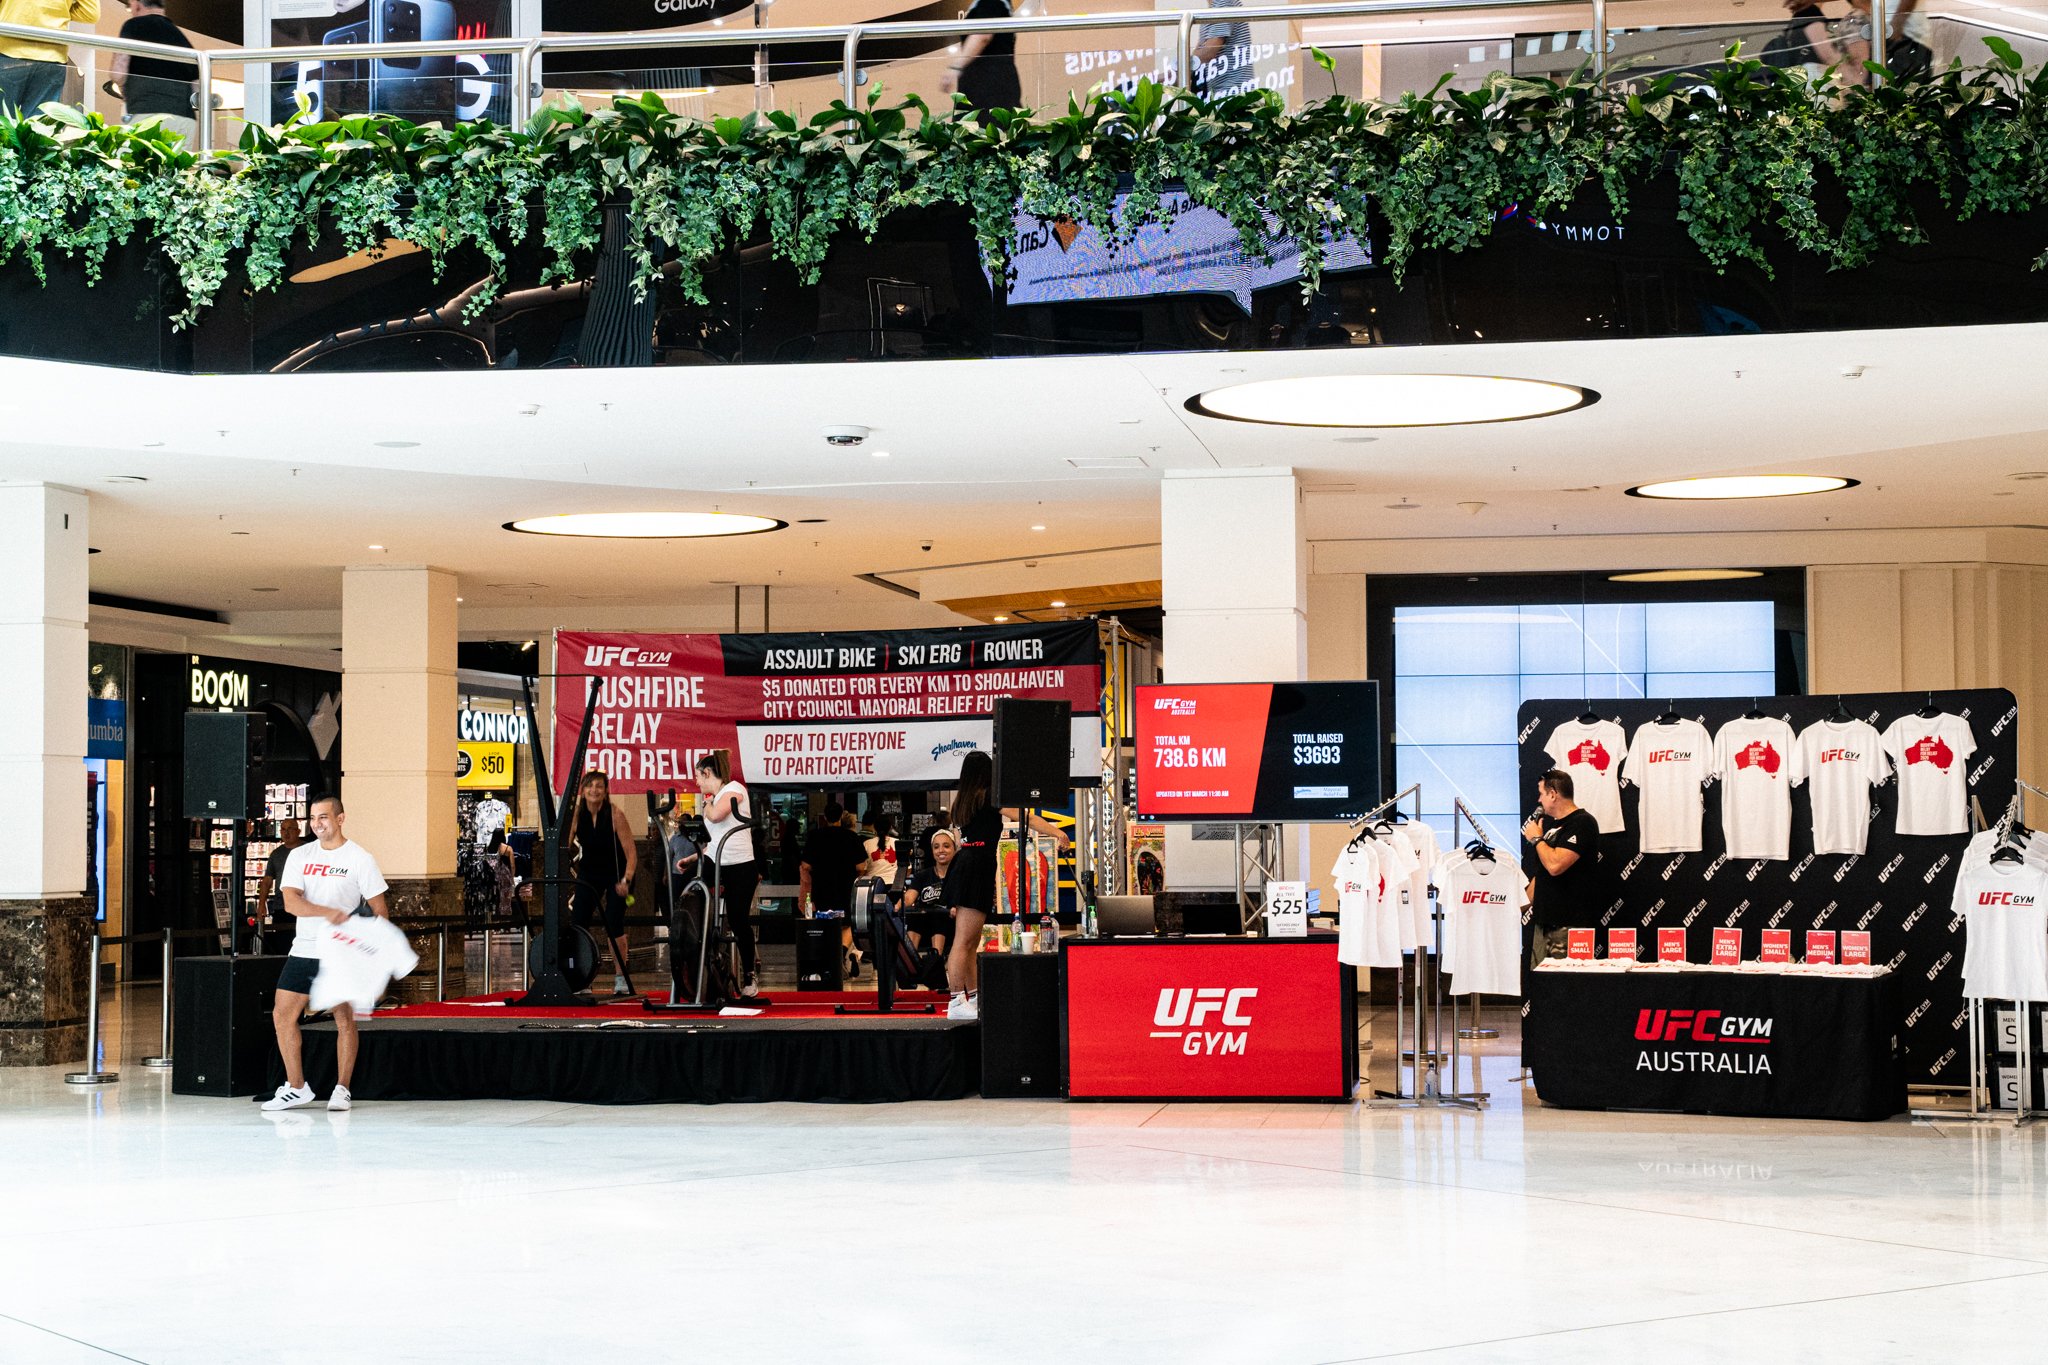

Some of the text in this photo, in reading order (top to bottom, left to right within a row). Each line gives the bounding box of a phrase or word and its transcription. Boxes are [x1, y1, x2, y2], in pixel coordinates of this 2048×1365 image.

[584, 646, 672, 667] UFC GYM
[763, 638, 1044, 670] ASSAULT BIKE SKI ERG ROWER
[762, 669, 1064, 698] $5 DONATED FOR EVERY KM TO SHOALHAVEN
[763, 693, 1012, 719] CITY COUNCIL MAYORAL RELIEF FU
[1154, 699, 1196, 709] UFC GYM
[460, 709, 528, 744] CONNOR
[1518, 724, 1532, 744] UFC
[1991, 715, 2010, 737] UFC
[764, 731, 906, 752] OPEN TO EVERYONE
[1155, 736, 1190, 746] TOTAL KM
[1293, 733, 1344, 744] TOTAL RAISED
[931, 739, 977, 761] Shoalhaven
[1153, 748, 1226, 768] 738.6 KM
[1293, 745, 1340, 766] $3693
[1649, 749, 1674, 763] UFC
[1820, 749, 1845, 763] UFC
[481, 756, 504, 774] $50
[763, 756, 874, 776] TO PARTICPATE
[1968, 765, 1987, 786] UFC
[303, 863, 348, 876] UFC GYM
[1620, 860, 1636, 881] UFC
[1661, 860, 1678, 881] UFC
[1703, 860, 1721, 882] UFC
[1746, 860, 1763, 882] UFC
[1789, 861, 1806, 883] UFC
[1833, 861, 1851, 883] UFC
[1878, 862, 1896, 884] UFC
[1923, 862, 1941, 884] UFC
[1272, 898, 1302, 917] $25
[1462, 891, 1490, 904] UFC
[1978, 892, 2035, 905] UFC GYM
[1600, 906, 1616, 927] UFC
[1641, 906, 1657, 927] UFC
[1682, 905, 1699, 927] UFC
[1725, 905, 1742, 928] UFC
[1768, 907, 1786, 929] UFC
[1812, 908, 1829, 930] UFC
[1856, 909, 1875, 930] UFC
[1901, 910, 1920, 932] UFC
[1926, 960, 1944, 981] UFC
[1154, 988, 1258, 1026] UFC
[1905, 1006, 1923, 1028] UFC
[1634, 1008, 1773, 1042] UFC GYM
[1182, 1032, 1248, 1055] GYM
[1636, 1051, 1772, 1075] AUSTRALIA
[1929, 1055, 1948, 1076] UFC
